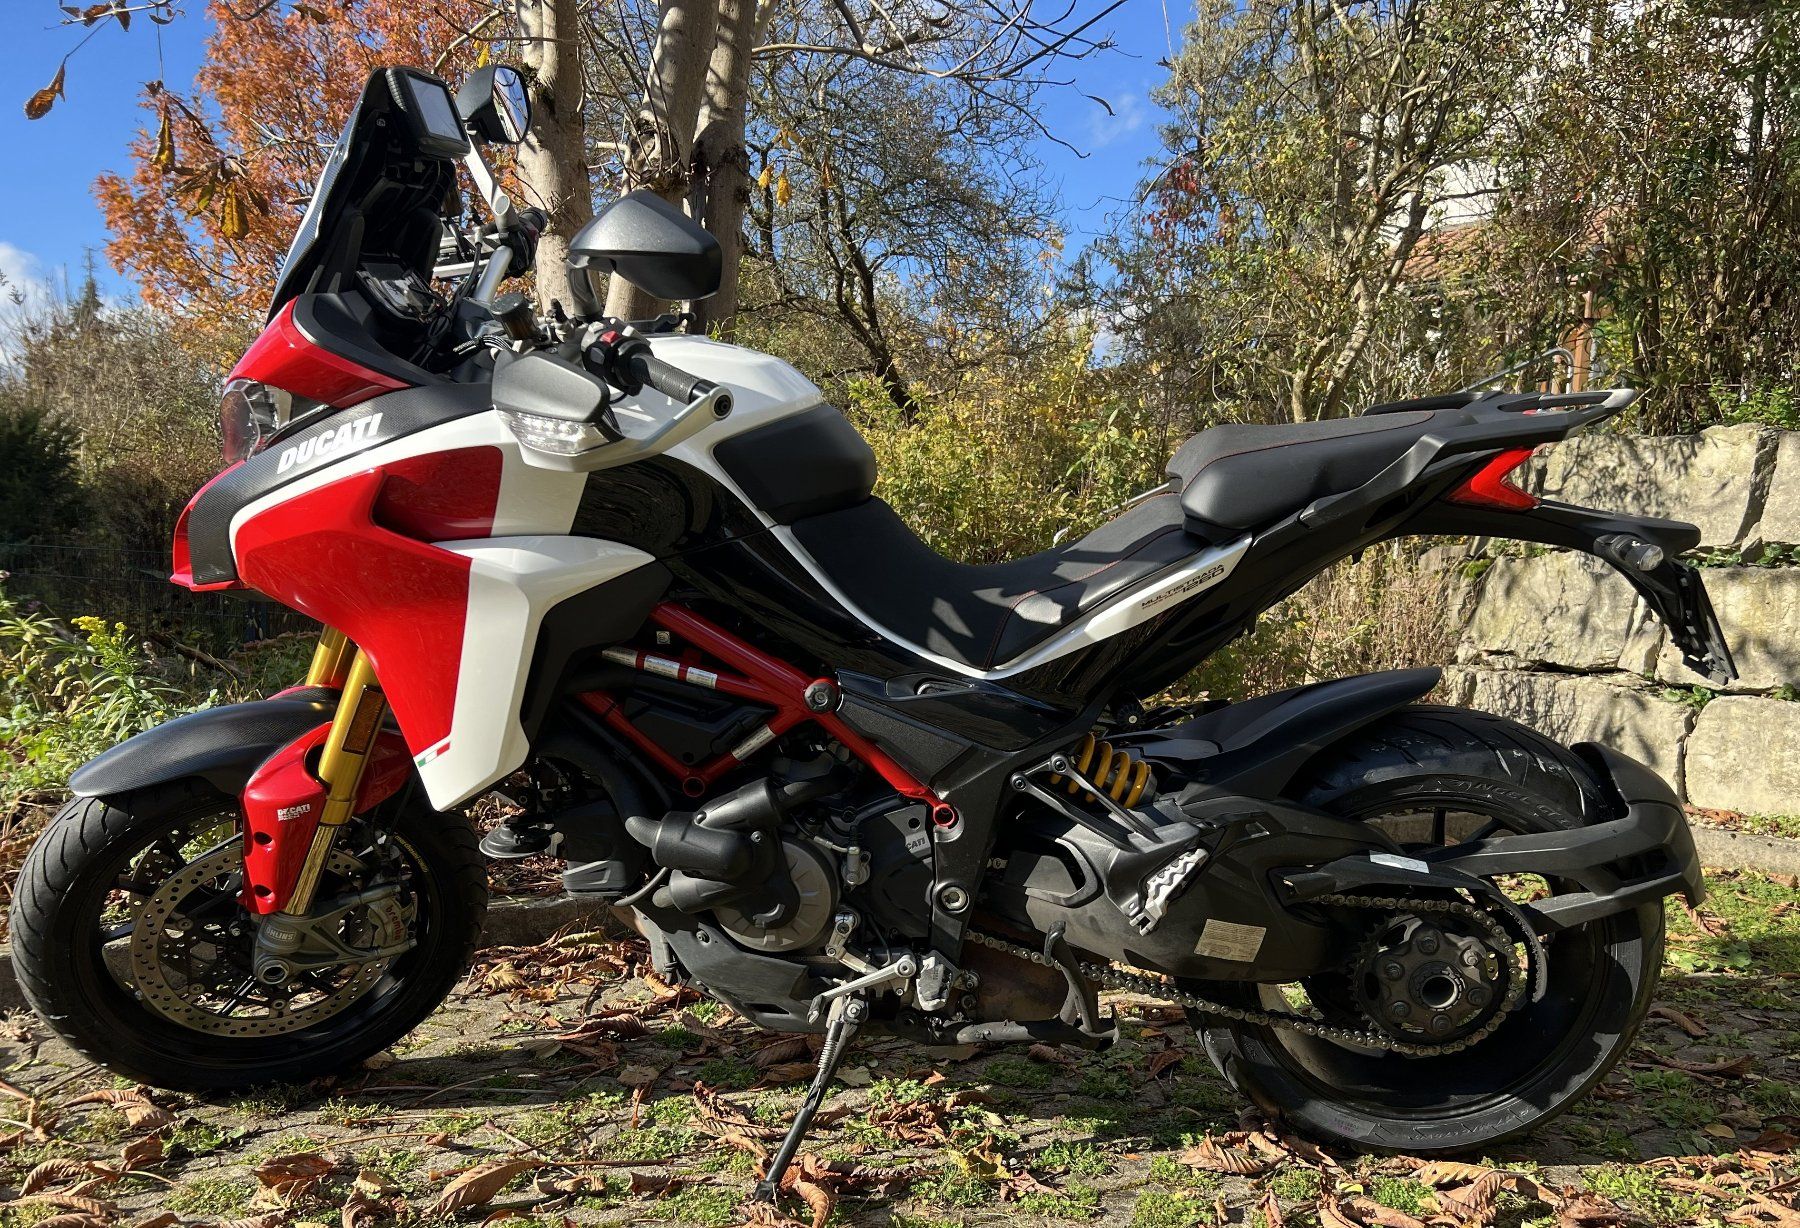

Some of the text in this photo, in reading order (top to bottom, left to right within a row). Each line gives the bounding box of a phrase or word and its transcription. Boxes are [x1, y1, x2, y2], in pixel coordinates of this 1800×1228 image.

[276, 412, 384, 475] DUCATI
[1141, 564, 1224, 607] MULTISTRADA
[385, 904, 404, 941] brembo
